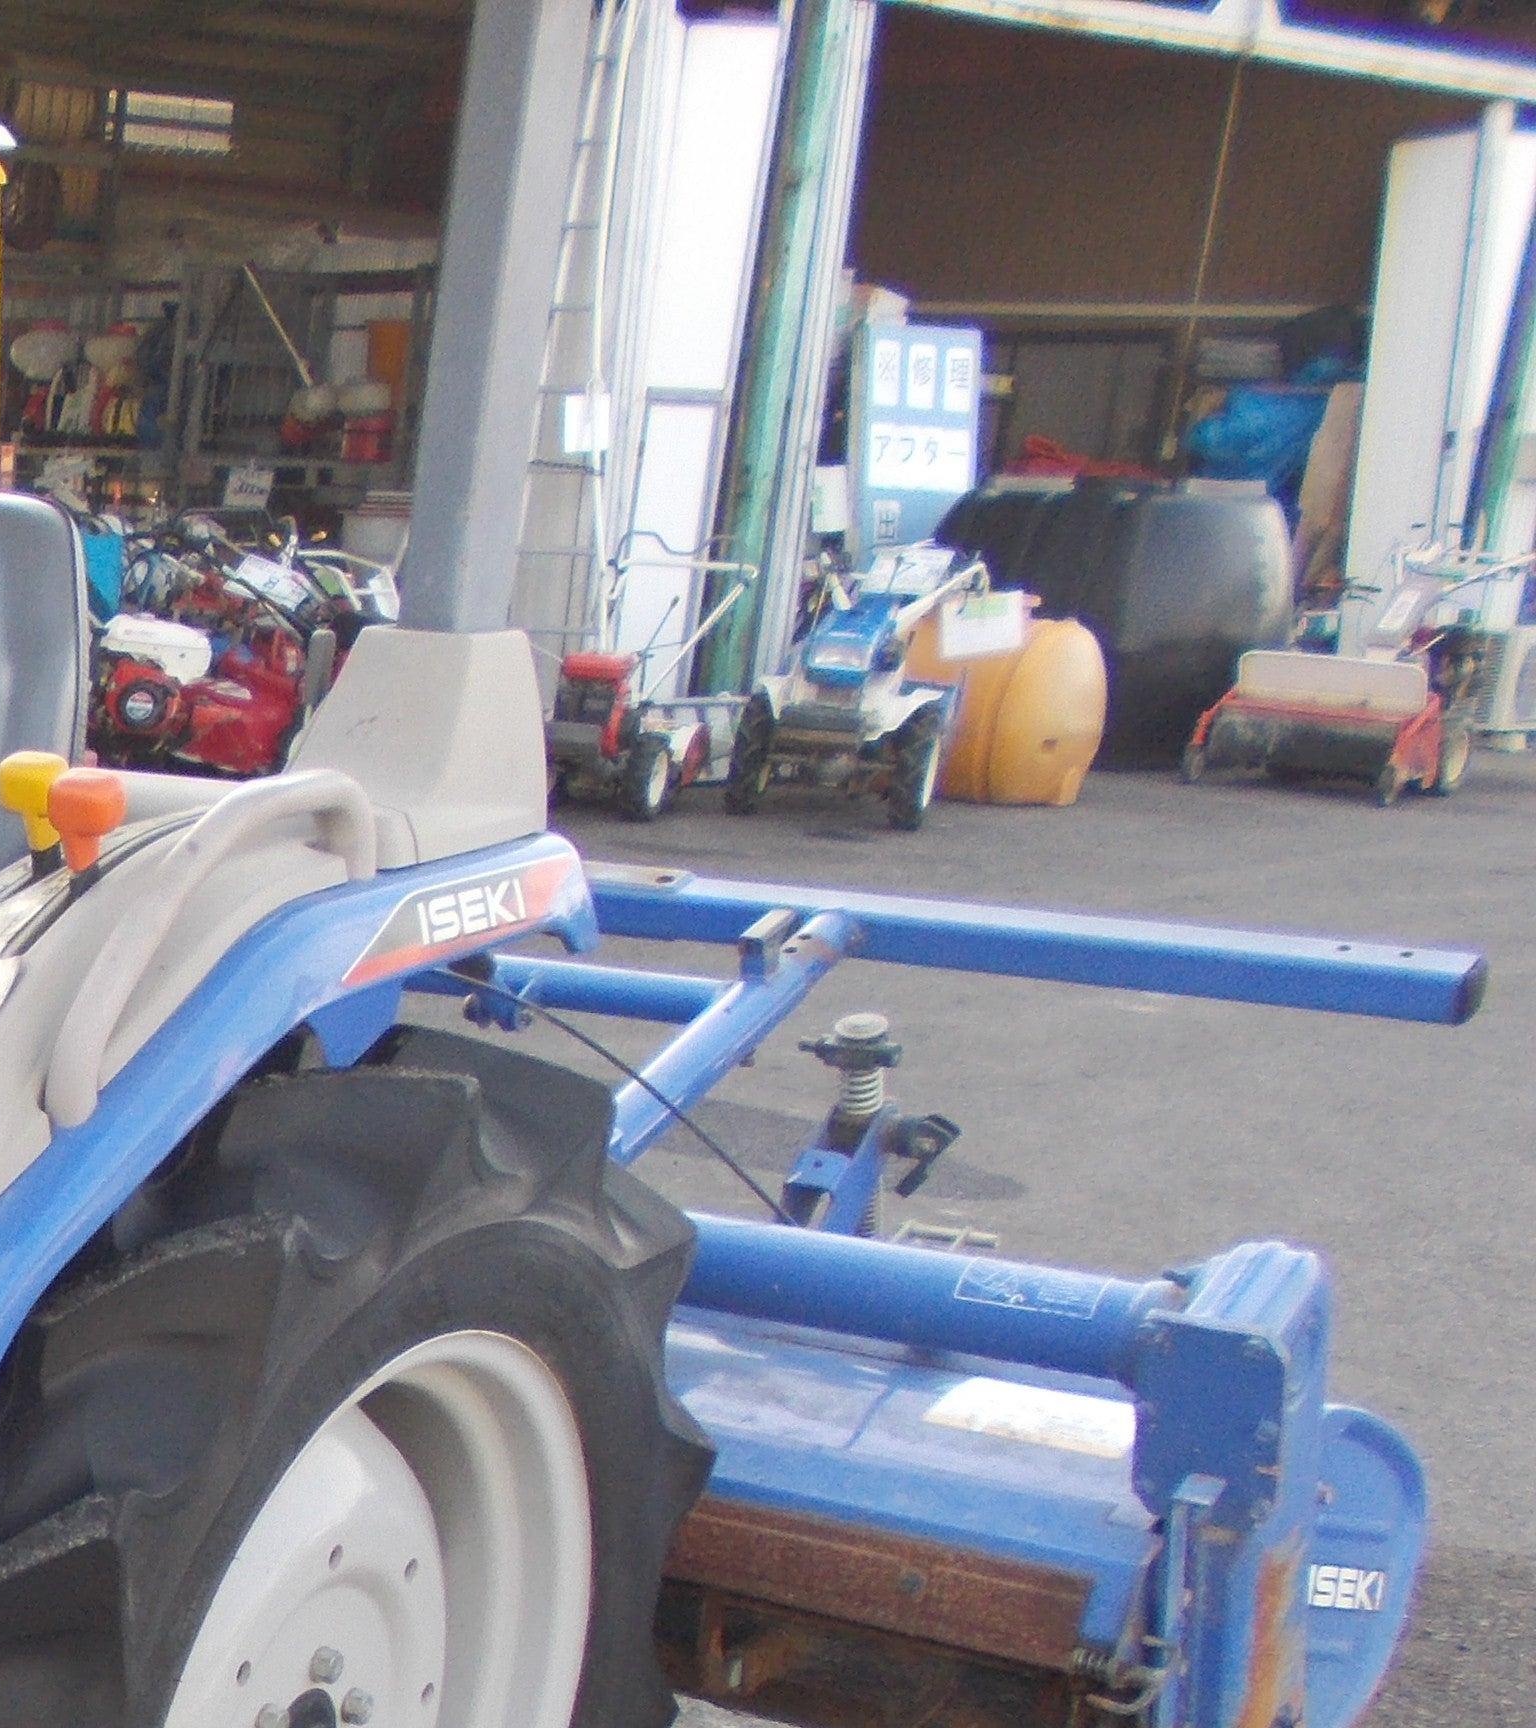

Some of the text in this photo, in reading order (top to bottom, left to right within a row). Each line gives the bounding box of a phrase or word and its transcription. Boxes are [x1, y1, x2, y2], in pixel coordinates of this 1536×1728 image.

[875, 434, 968, 467] アフター
[416, 878, 527, 946] ISEKI
[1308, 1563, 1385, 1611] ISEKI
